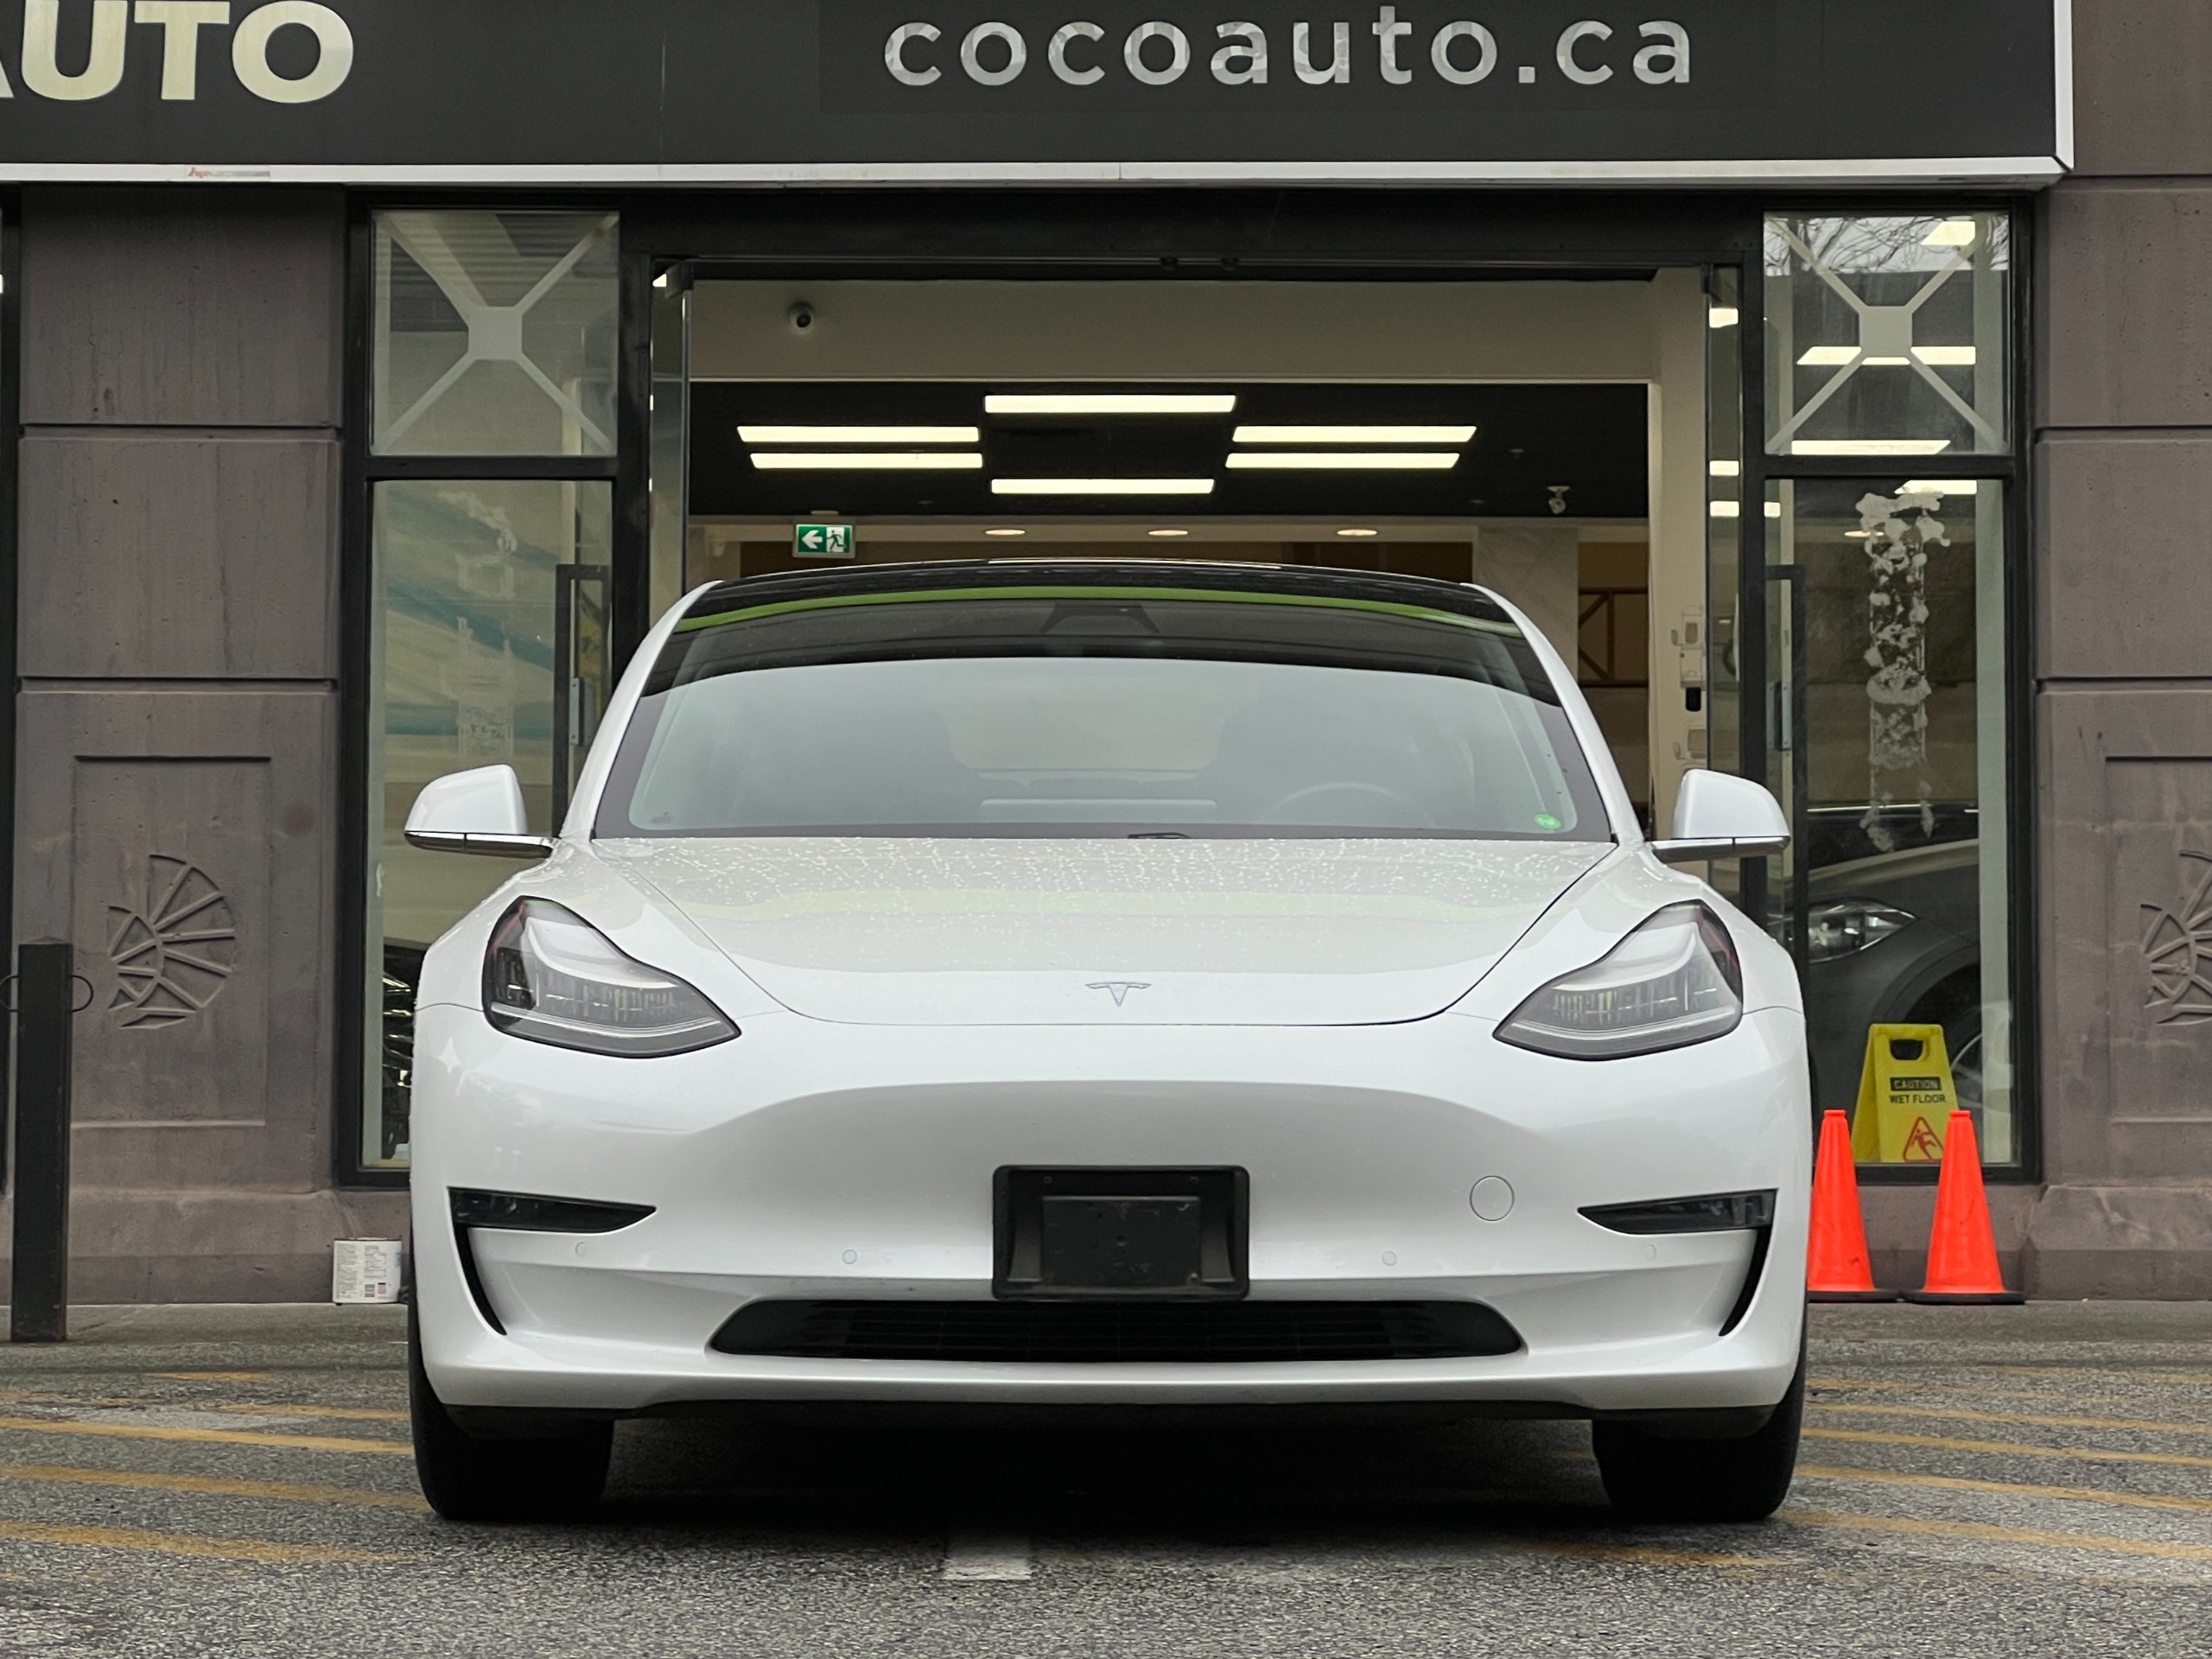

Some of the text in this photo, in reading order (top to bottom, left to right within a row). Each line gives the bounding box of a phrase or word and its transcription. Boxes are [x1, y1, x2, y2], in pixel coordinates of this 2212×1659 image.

[0, 0, 353, 103] UTO
[884, 5, 1690, 86] cocoauto.ca
[1890, 1094, 1946, 1103] WET FLOOR
[1893, 1079, 1938, 1090] CAUTION
